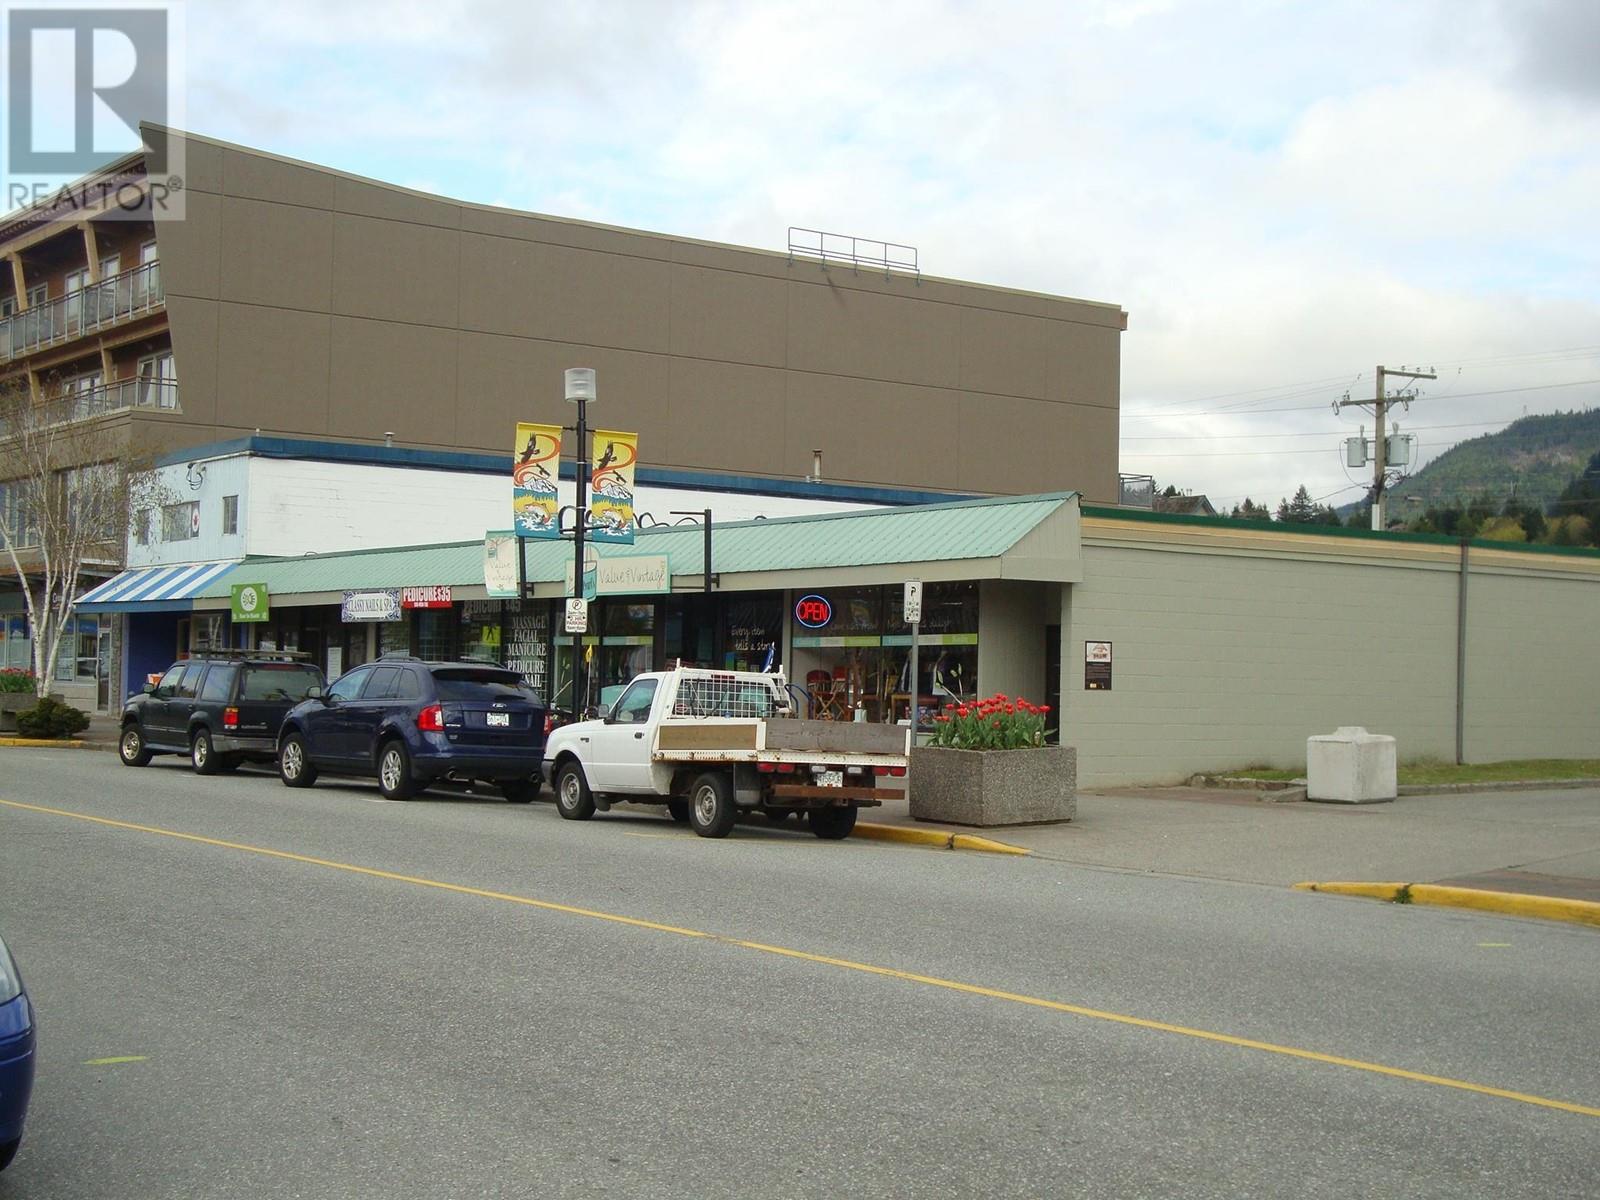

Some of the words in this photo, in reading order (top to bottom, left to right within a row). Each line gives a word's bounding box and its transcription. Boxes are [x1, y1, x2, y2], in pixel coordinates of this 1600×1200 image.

[600, 569, 624, 584] Value
[631, 567, 665, 589] Vintage
[403, 587, 437, 602] PEDICURE
[437, 586, 451, 602] $35
[799, 601, 828, 621] OPEN
[512, 616, 546, 629] MASSAGE
[514, 629, 539, 643] FACIAL
[508, 643, 547, 656] MANICURE
[507, 660, 545, 674] PEDICURE
